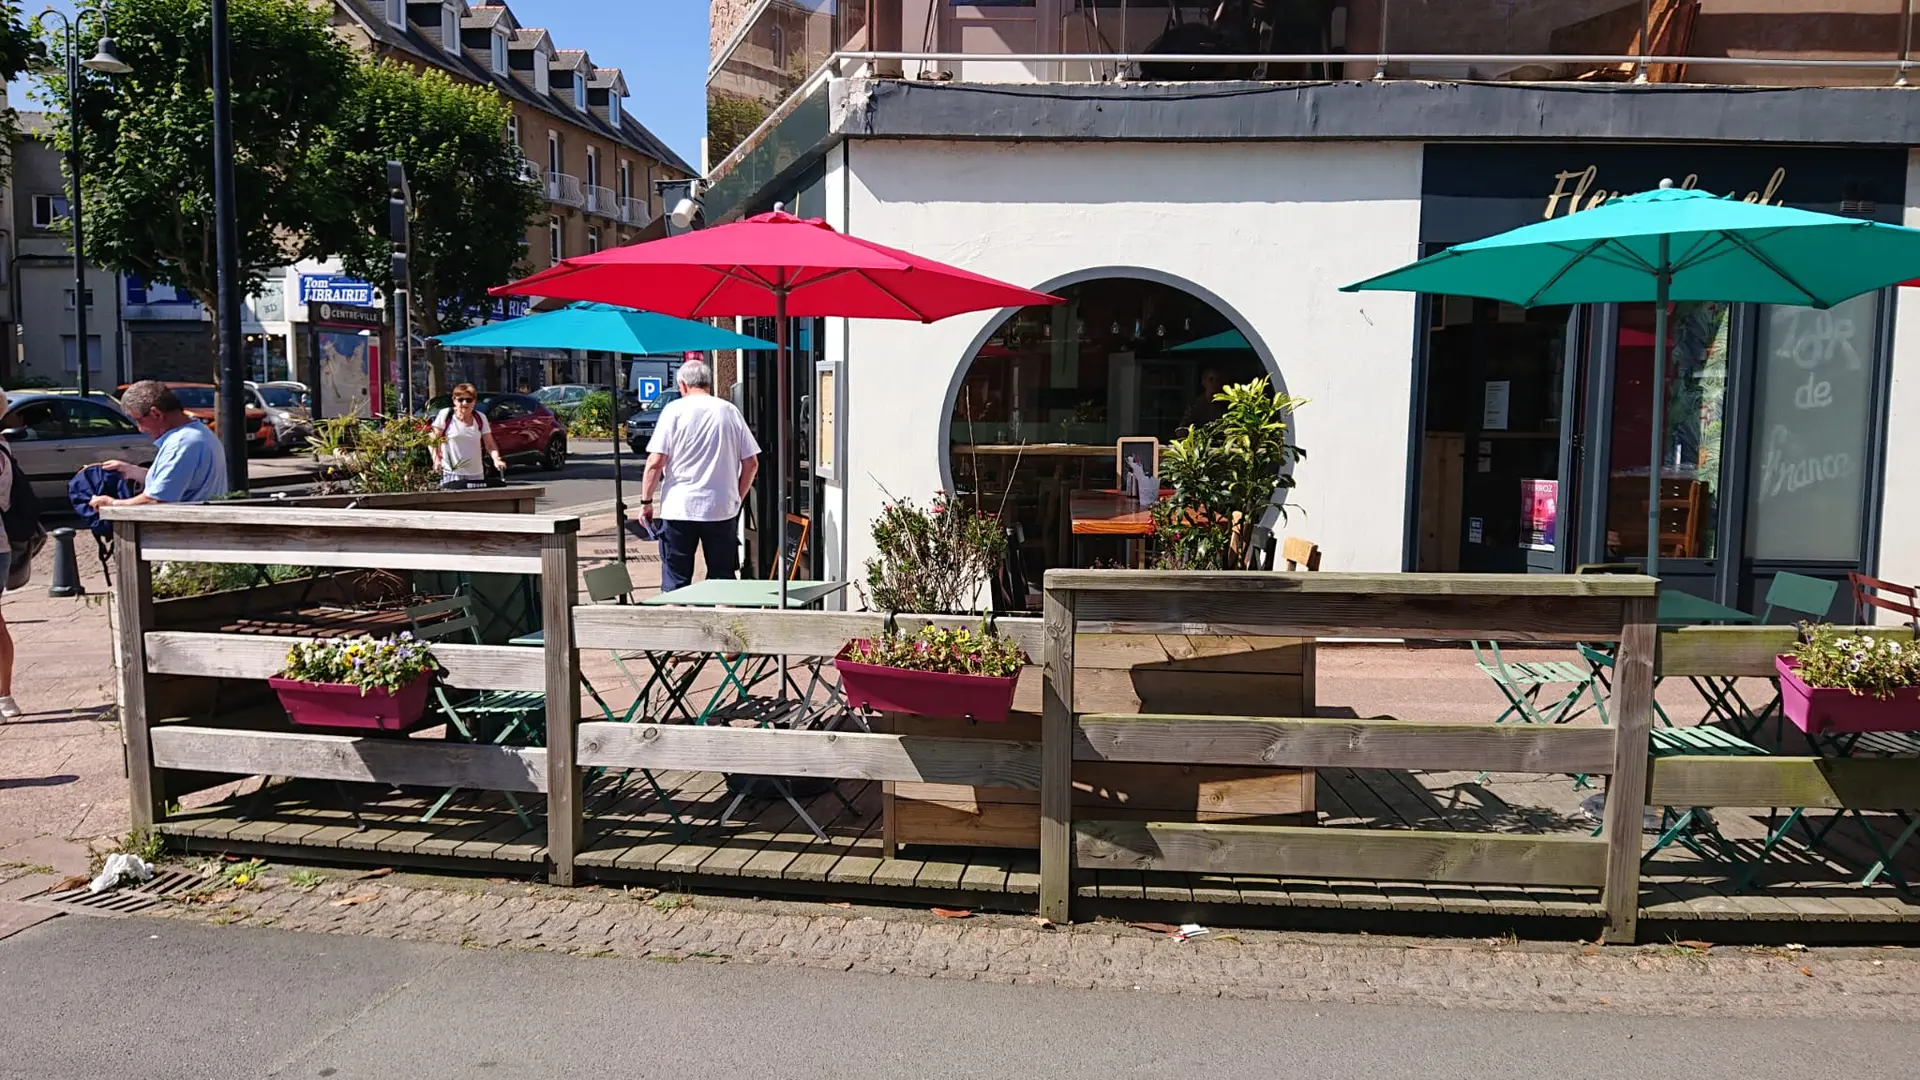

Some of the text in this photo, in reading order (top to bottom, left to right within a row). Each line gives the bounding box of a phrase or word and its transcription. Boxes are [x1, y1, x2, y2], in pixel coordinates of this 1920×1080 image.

[304, 277, 329, 288] Tom
[304, 288, 368, 302] LIBRAIRIE
[331, 308, 378, 322] CENTRE-VILLE
[644, 381, 656, 398] P
[1794, 371, 1834, 410] de
